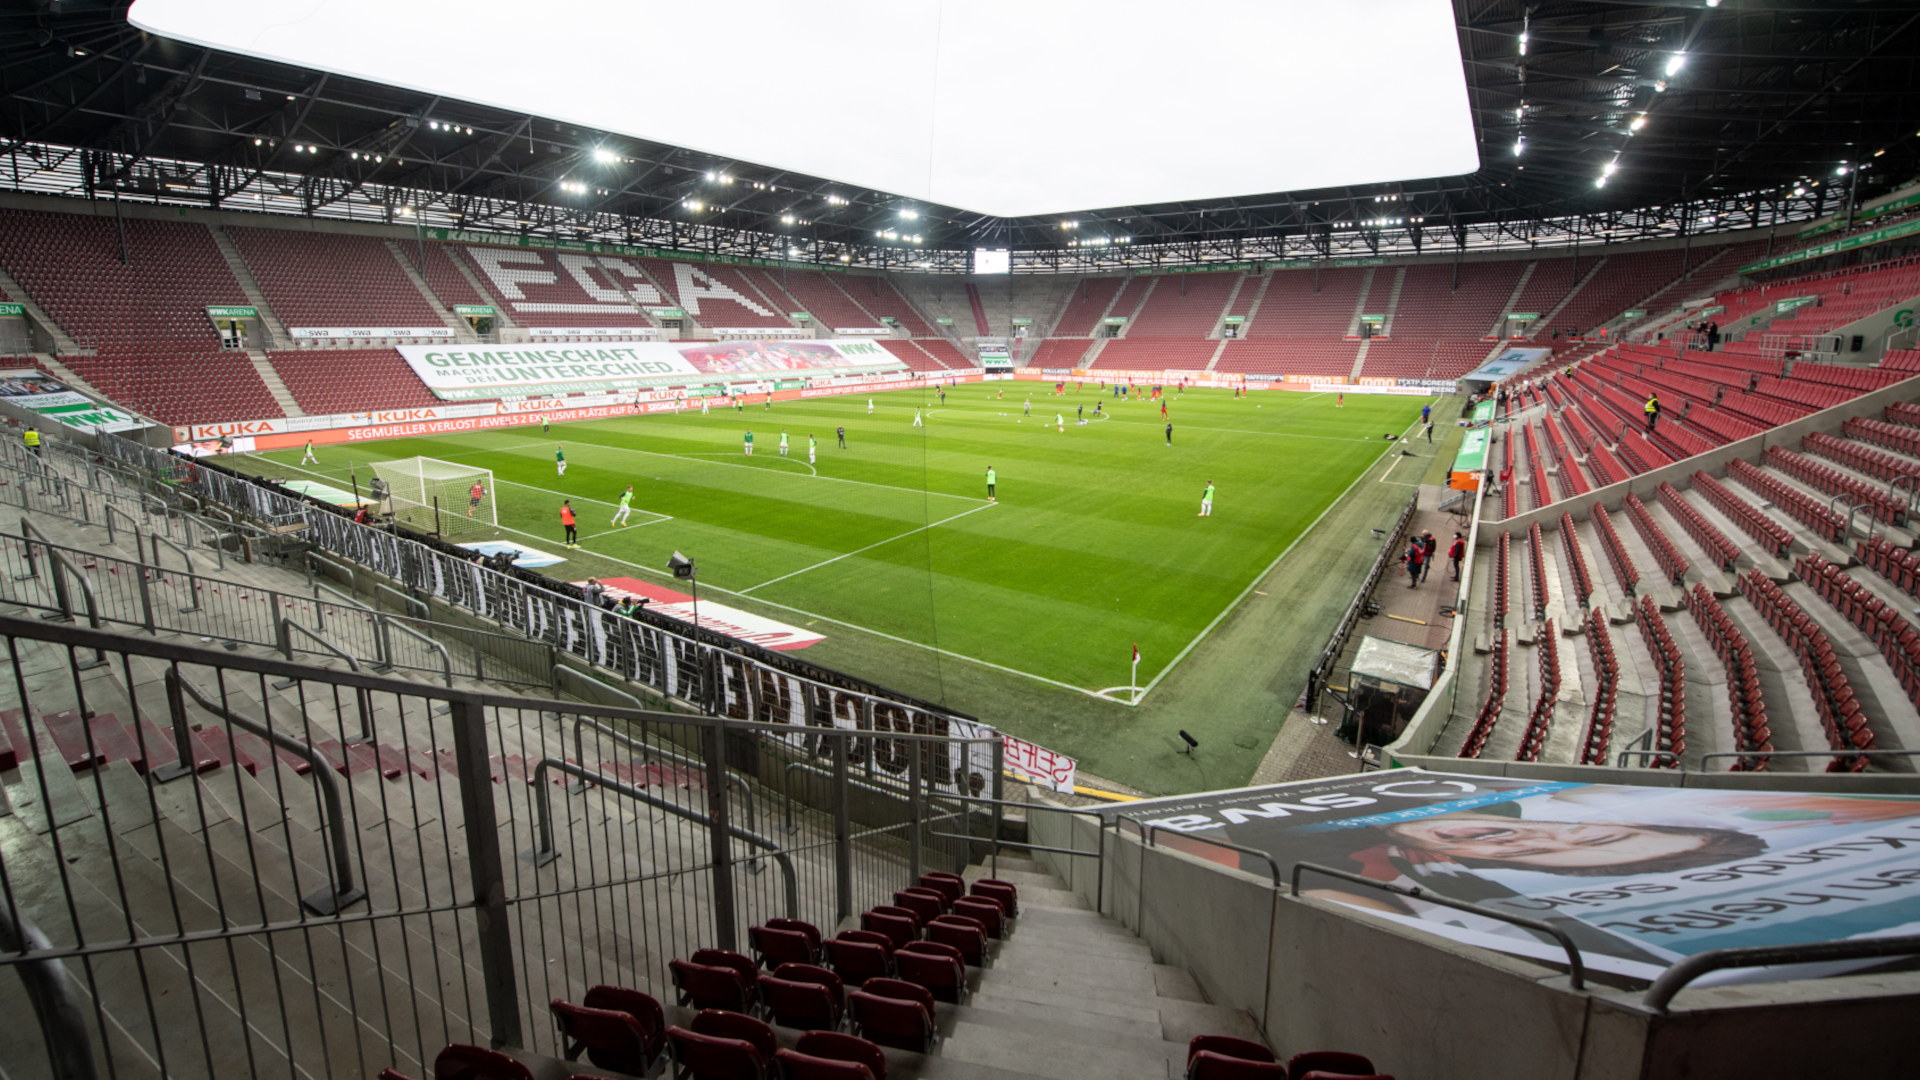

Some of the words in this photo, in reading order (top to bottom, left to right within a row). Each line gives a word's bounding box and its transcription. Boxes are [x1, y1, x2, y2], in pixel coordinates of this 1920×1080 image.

[446, 230, 520, 245] KASTNER
[623, 247, 657, 257] GW-TEC
[1894, 309, 1914, 328] G
[308, 329, 329, 337] swa
[836, 343, 882, 355] WWK
[425, 348, 639, 367] GEMEINSCHAFT
[436, 368, 490, 377] MACHT
[493, 361, 682, 381] UNTERSCHIED.
[864, 375, 886, 383] KUKA
[438, 390, 479, 399] WWK
[481, 382, 606, 396] VERSICHERUNGEN
[611, 380, 642, 388] WWK
[641, 374, 734, 386] VERSICHERUNGEN
[649, 390, 685, 401] KUKA
[518, 399, 565, 411] KUKA
[53, 411, 131, 427] WWK
[348, 423, 427, 440] SEGMUELLER
[429, 419, 476, 433] VERLOST
[479, 415, 519, 427] JEWEILS
[520, 414, 526, 423] 2
[578, 407, 608, 419] PLÄTZE
[609, 405, 626, 414] AUF
[627, 403, 644, 413] DN
[378, 409, 437, 423] KUKA
[198, 421, 274, 438] KUKA
[1144, 792, 1379, 832] swa
[1680, 835, 1920, 883] Kunde
[1497, 883, 1678, 911] sein
[1599, 892, 1868, 936] heißt
